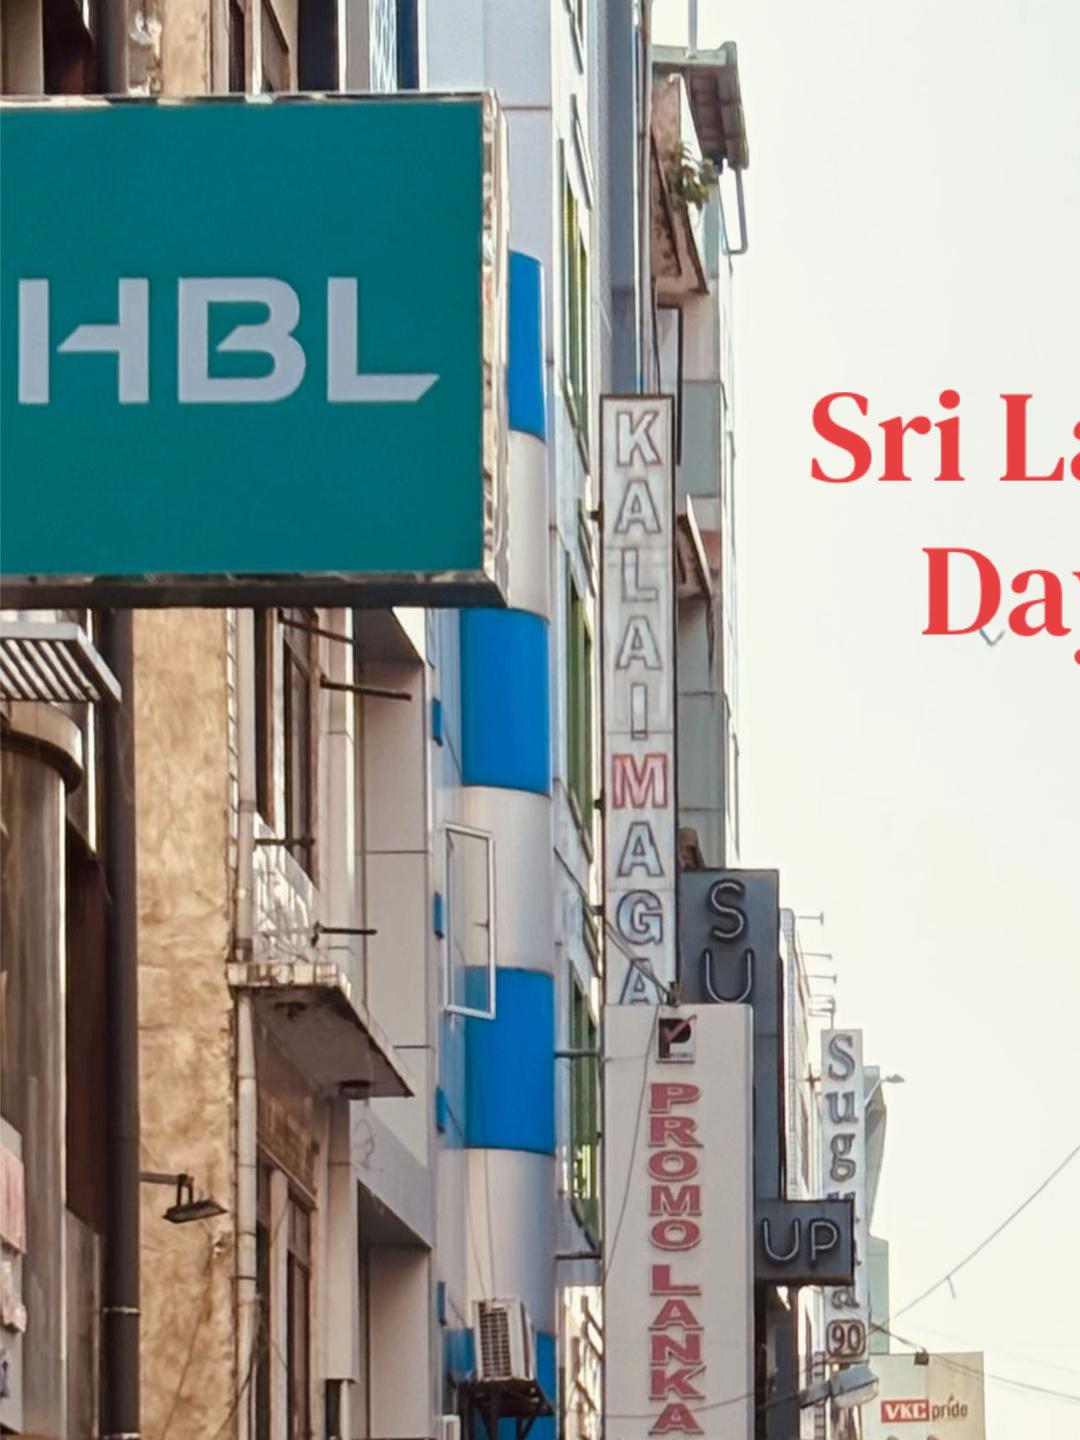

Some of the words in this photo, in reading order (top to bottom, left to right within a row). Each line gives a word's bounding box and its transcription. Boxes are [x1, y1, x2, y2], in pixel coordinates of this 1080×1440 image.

[18, 276, 441, 403] HBL
[647, 1082, 704, 1252] PROMO
[760, 1216, 840, 1267] UP
[648, 1264, 706, 1436] LANKA
[830, 1323, 862, 1354] 90
[884, 1402, 928, 1420] VKC
[931, 1395, 968, 1422] pride
